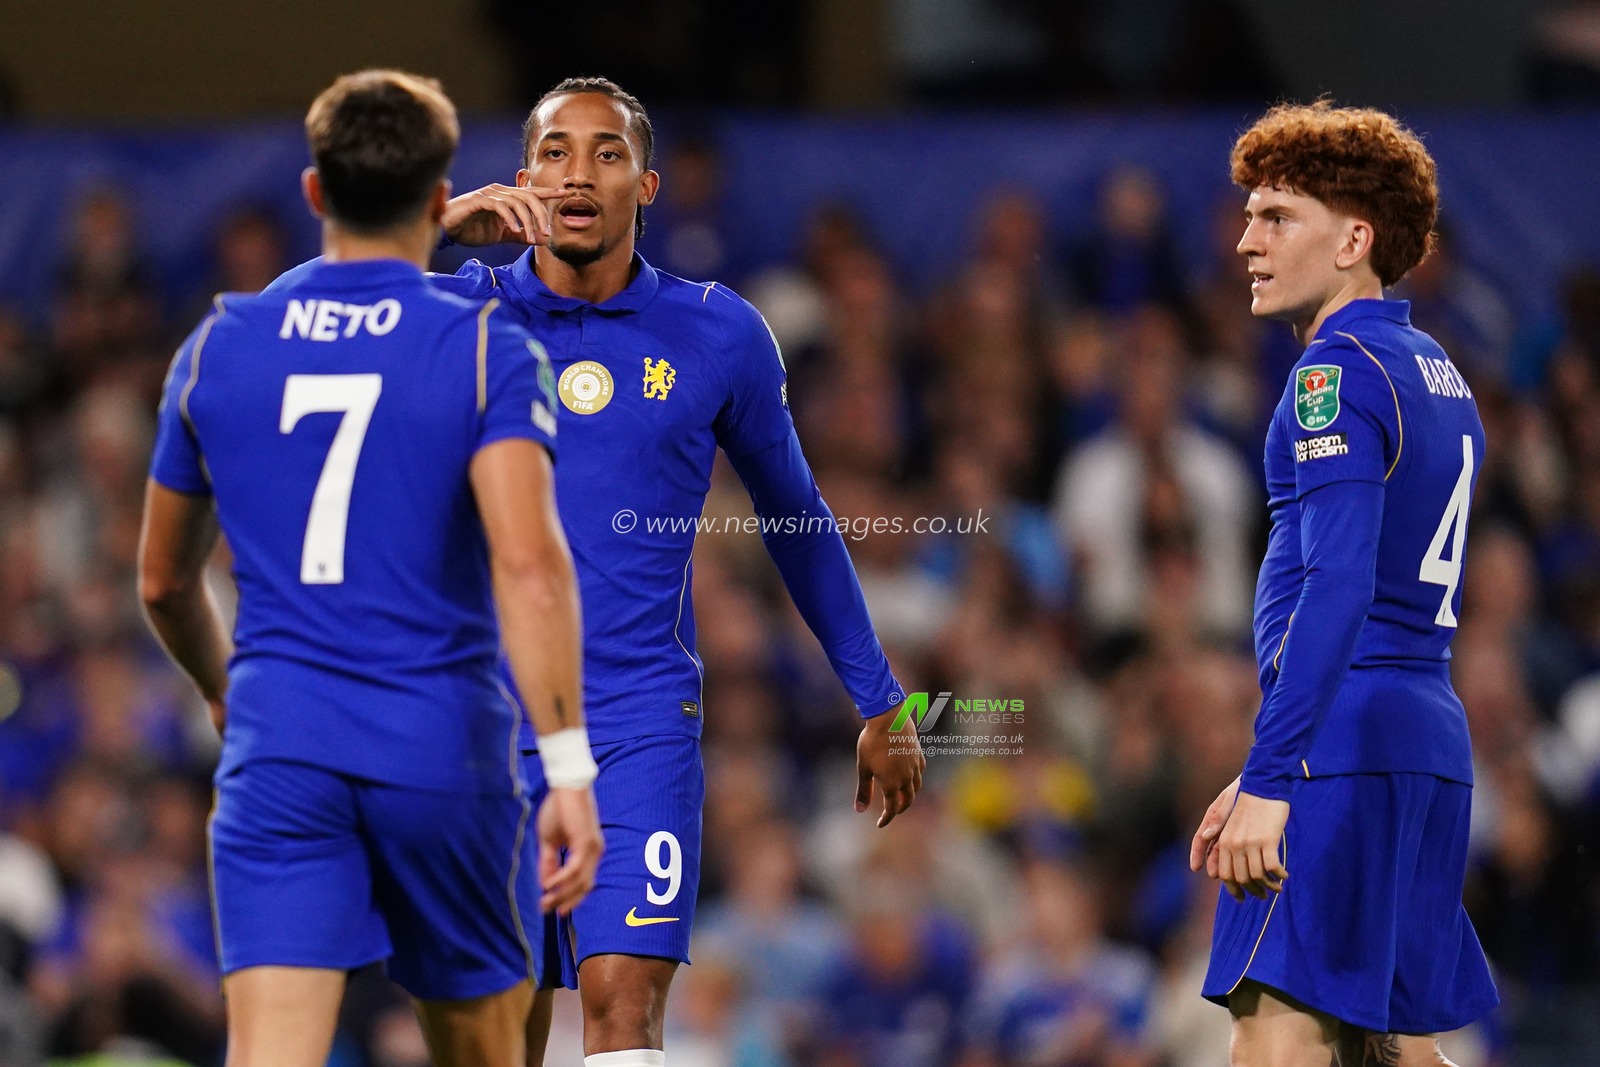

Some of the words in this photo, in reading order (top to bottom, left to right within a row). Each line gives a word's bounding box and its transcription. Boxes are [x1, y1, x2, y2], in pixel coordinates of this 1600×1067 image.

[279, 298, 402, 342] NETO
[564, 367, 580, 391] WORLD
[580, 364, 609, 397] CHAMPIONS
[1298, 385, 1334, 404] Carabao
[1307, 396, 1324, 408] Cup
[572, 400, 594, 410] FIFA
[1316, 415, 1327, 423] EFL
[1294, 440, 1308, 452] No
[1308, 434, 1341, 450] room
[1296, 450, 1309, 464] for
[1309, 444, 1348, 460] racism
[279, 373, 383, 584] 7
[1418, 434, 1474, 628] 4
[644, 830, 682, 906] 9
